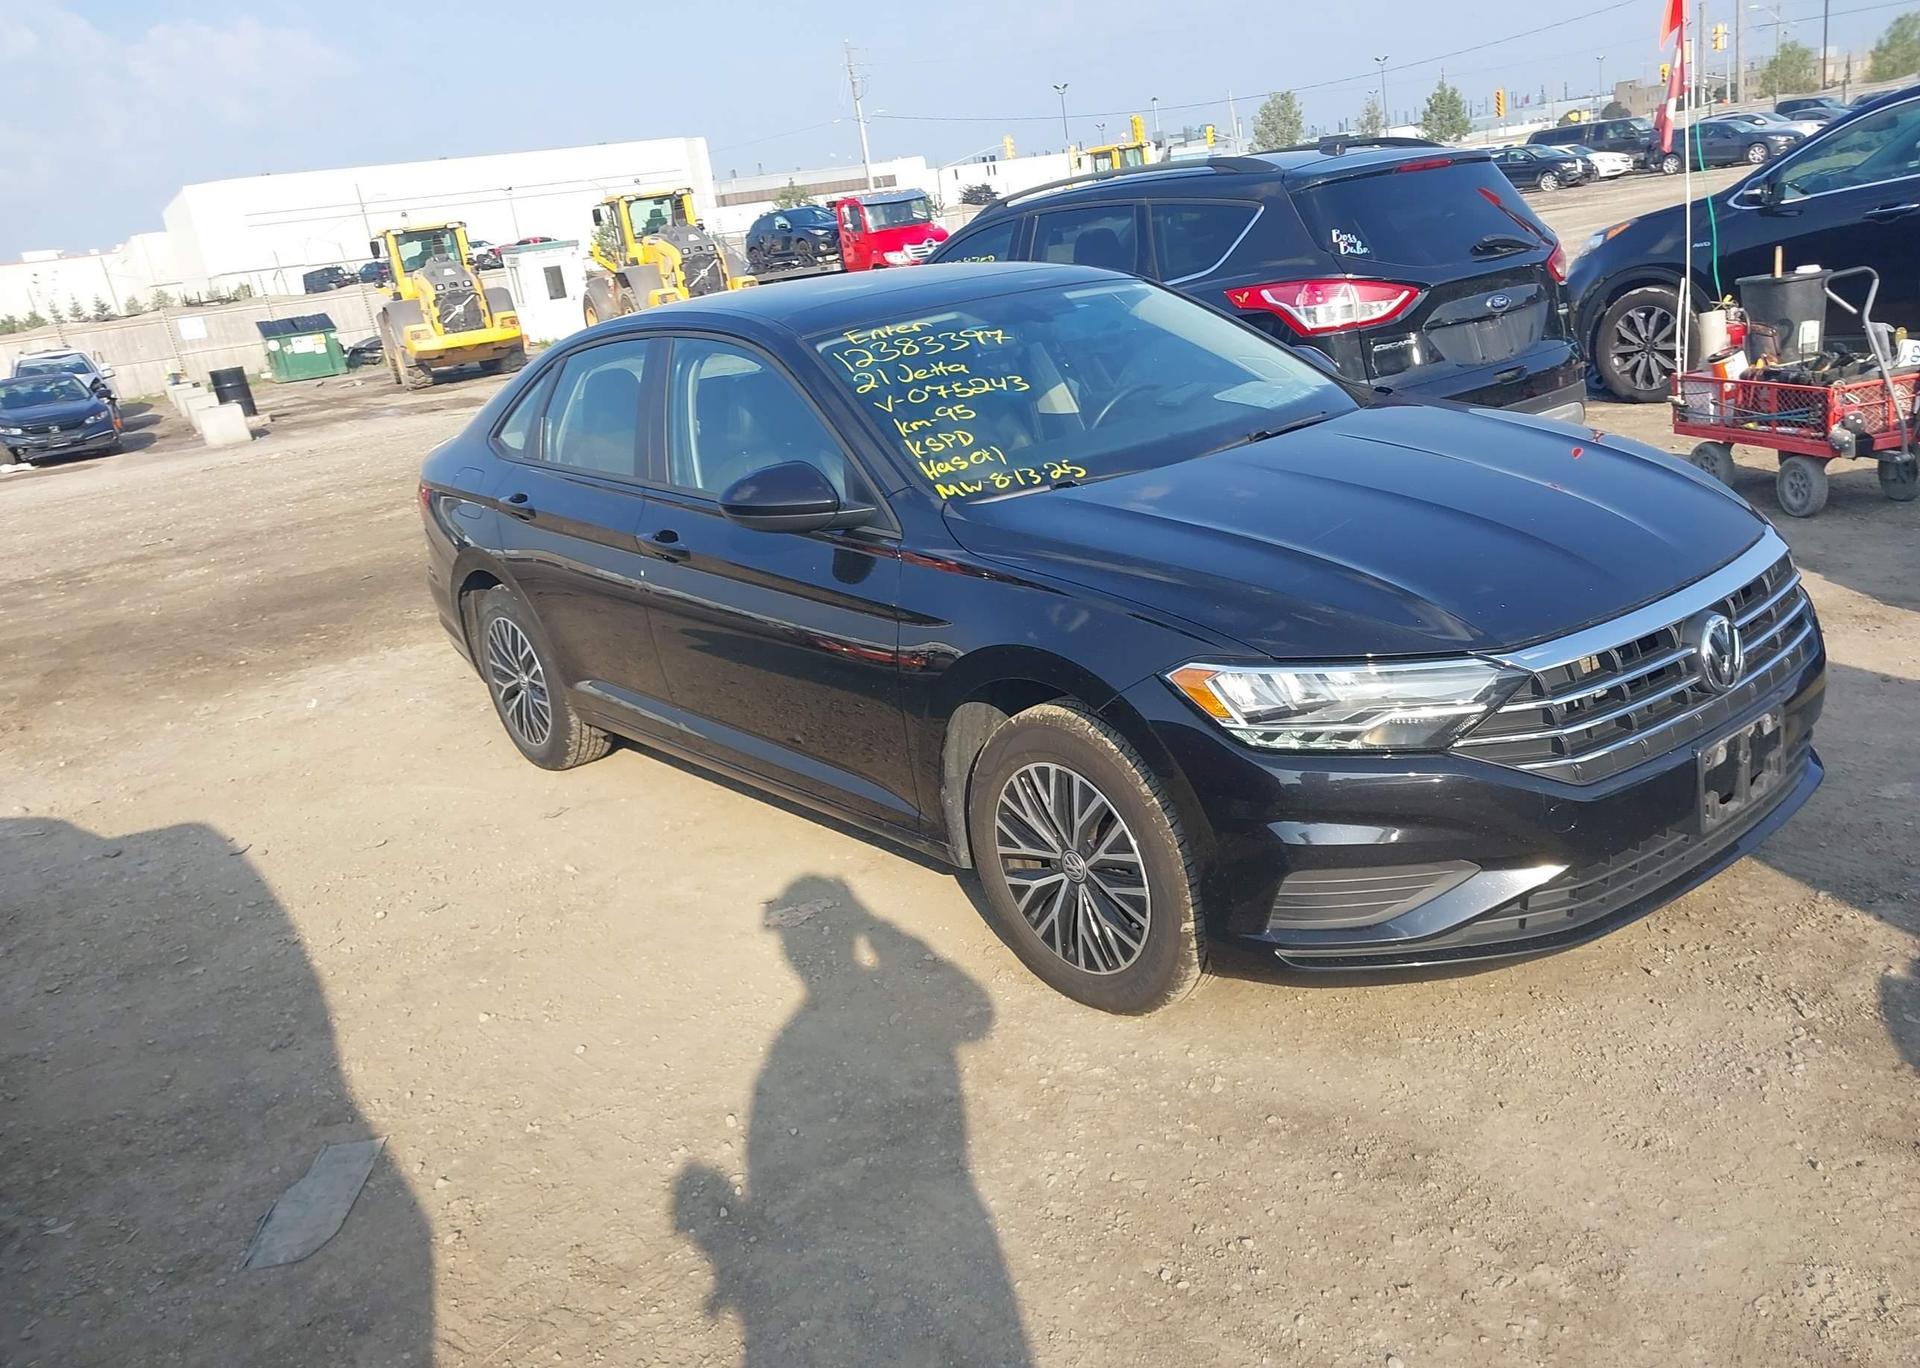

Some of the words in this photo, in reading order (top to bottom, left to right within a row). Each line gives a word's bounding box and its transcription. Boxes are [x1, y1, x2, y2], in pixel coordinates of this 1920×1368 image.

[1331, 229, 1357, 243] Boss
[832, 329, 1014, 373] 12383397
[853, 369, 891, 394] 21
[897, 361, 970, 383] Jetta
